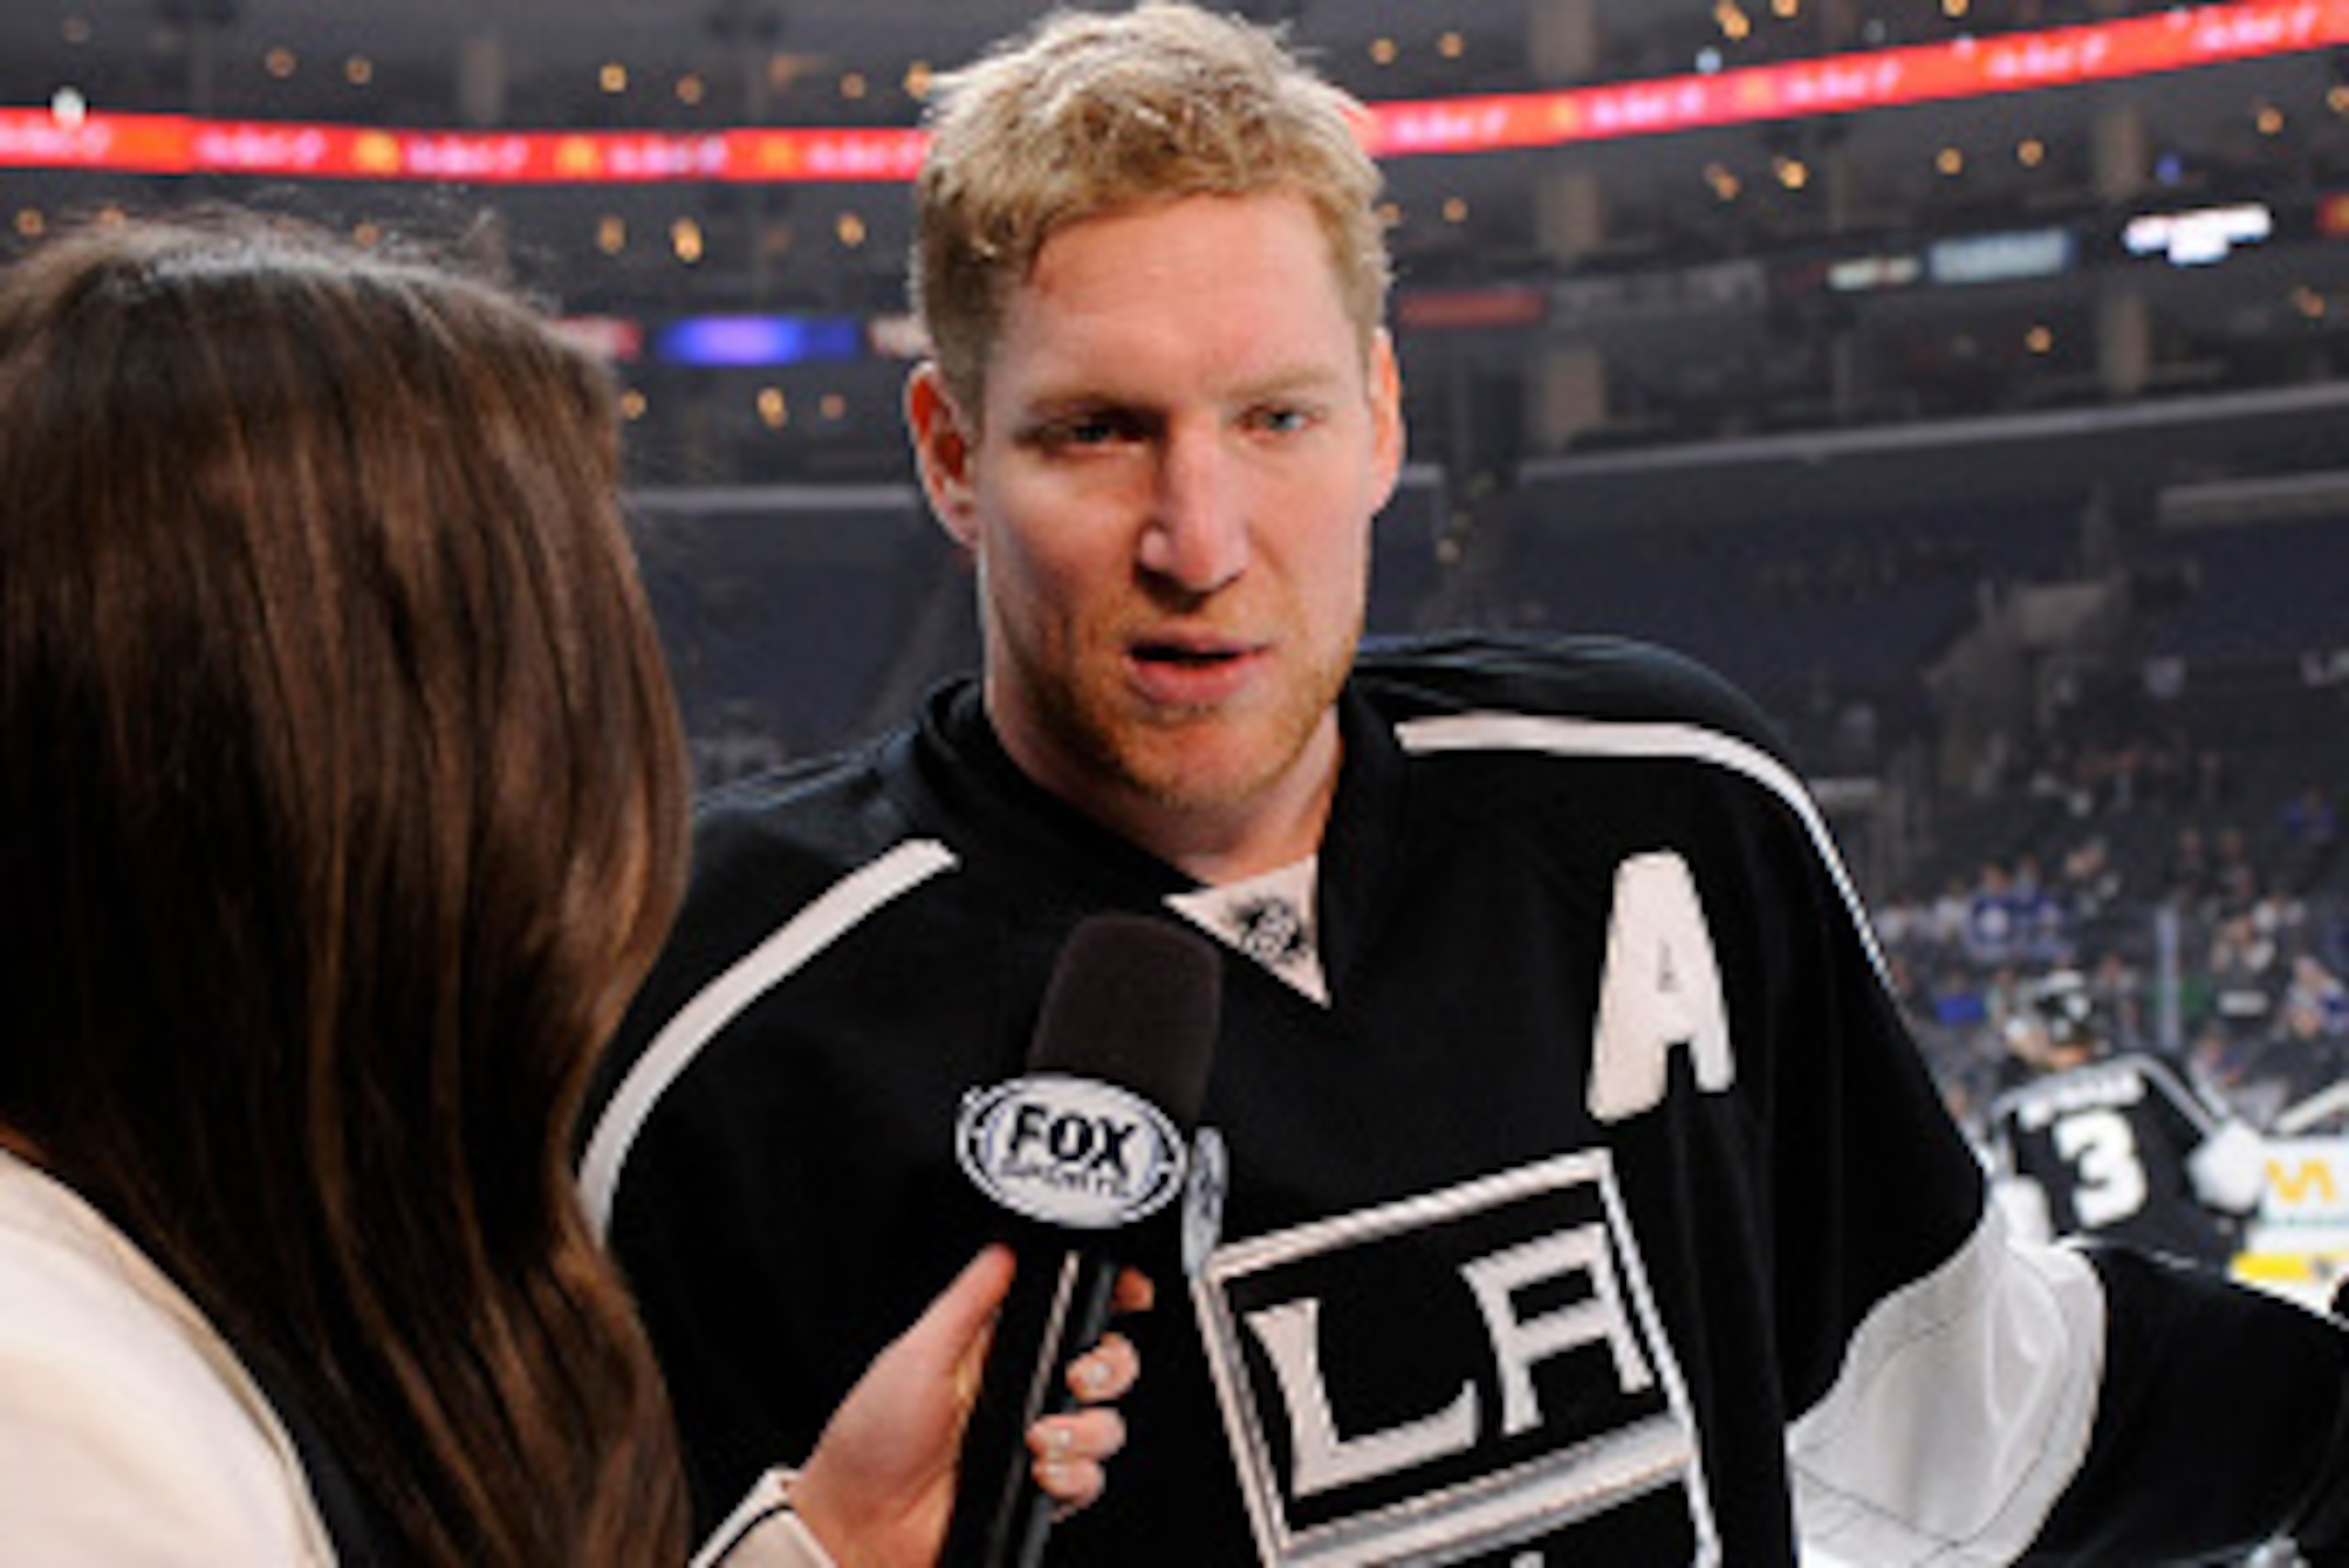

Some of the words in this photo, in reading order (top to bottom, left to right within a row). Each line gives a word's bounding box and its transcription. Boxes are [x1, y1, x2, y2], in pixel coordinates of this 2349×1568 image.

[1588, 851, 1735, 1122] A
[1010, 1104, 1137, 1178] FOX
[2054, 1109, 2147, 1228] 3
[1243, 1222, 1653, 1496] LA
